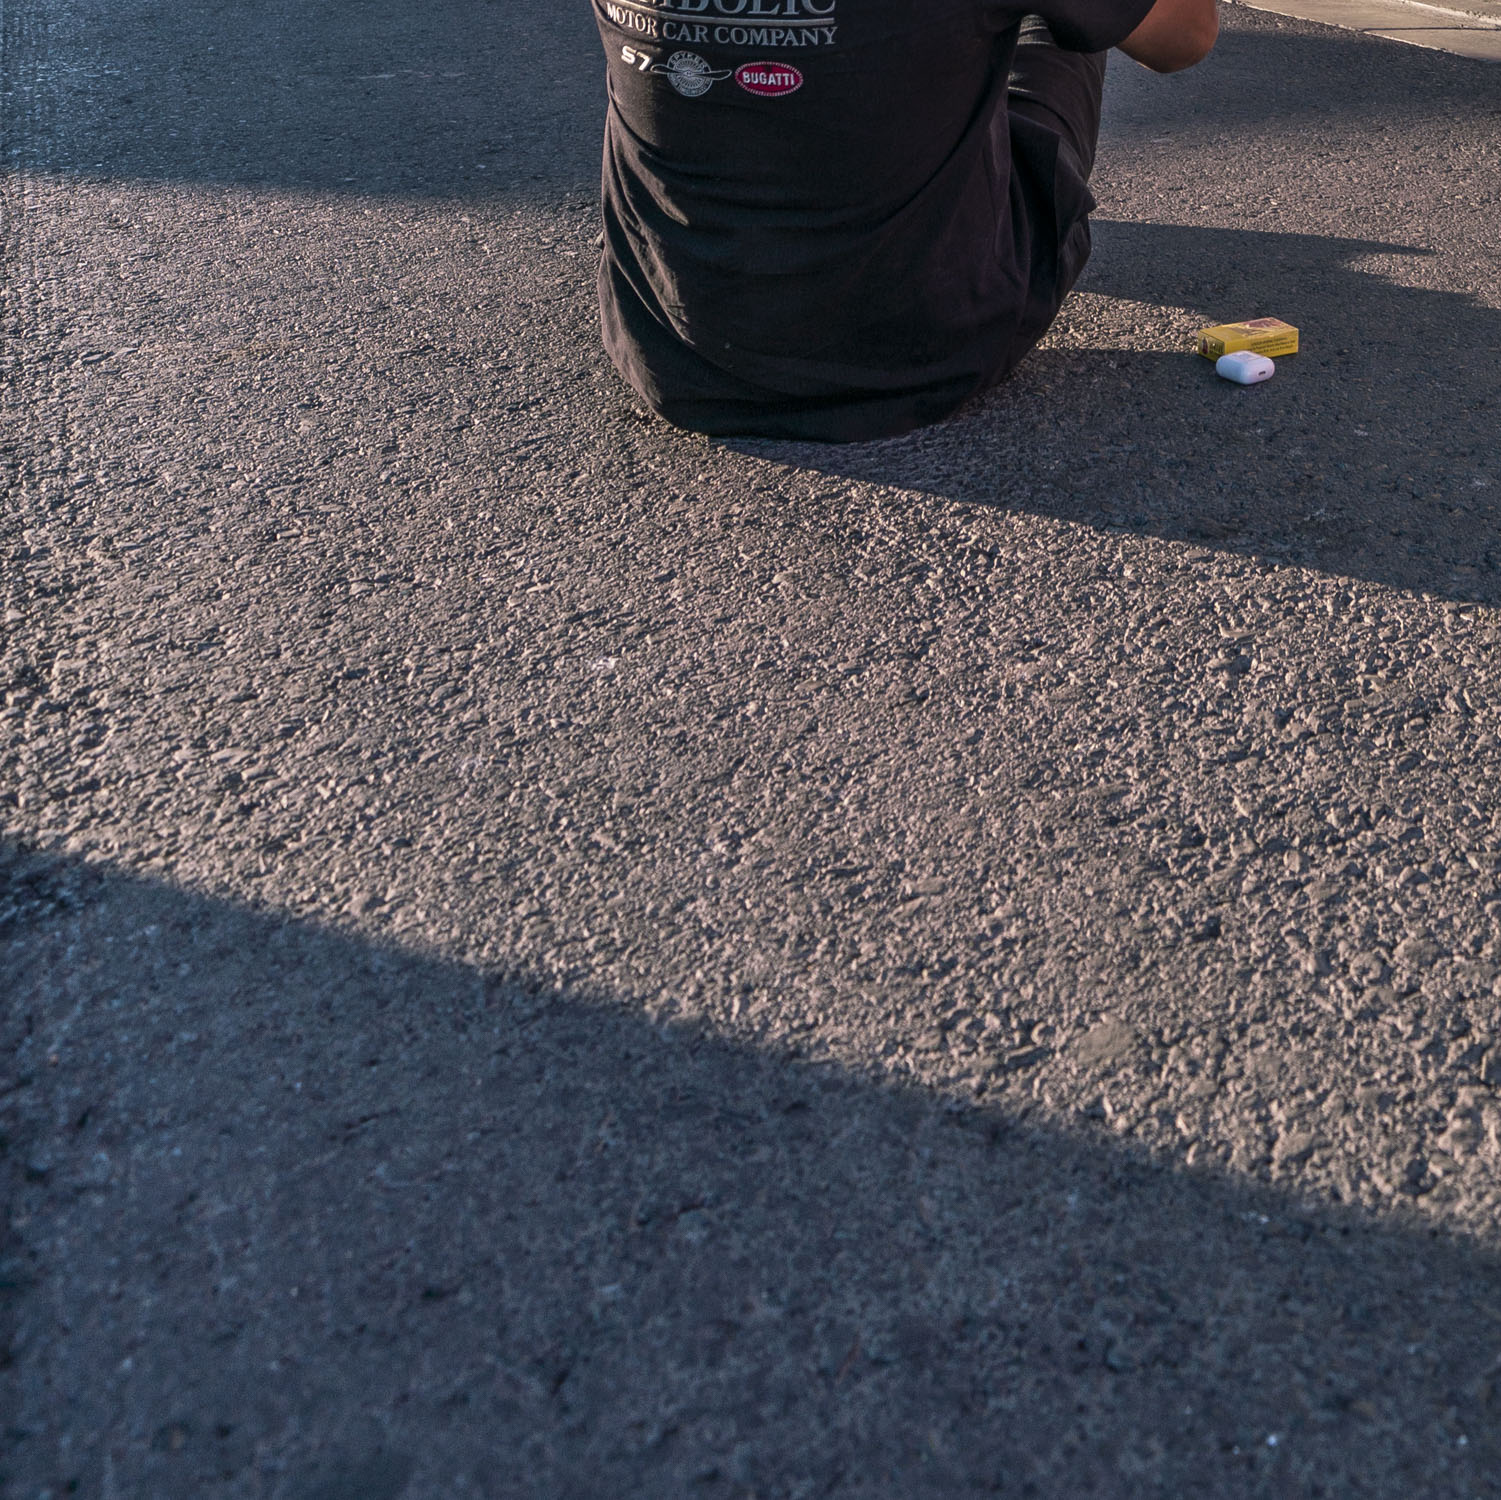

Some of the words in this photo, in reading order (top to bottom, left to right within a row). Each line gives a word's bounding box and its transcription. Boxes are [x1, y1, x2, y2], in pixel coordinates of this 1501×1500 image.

[606, 2, 658, 38] MOTOR
[662, 21, 710, 44] CAR
[713, 26, 839, 47] COMPANY
[621, 45, 652, 72] S7
[742, 71, 795, 87] BUGATTI
